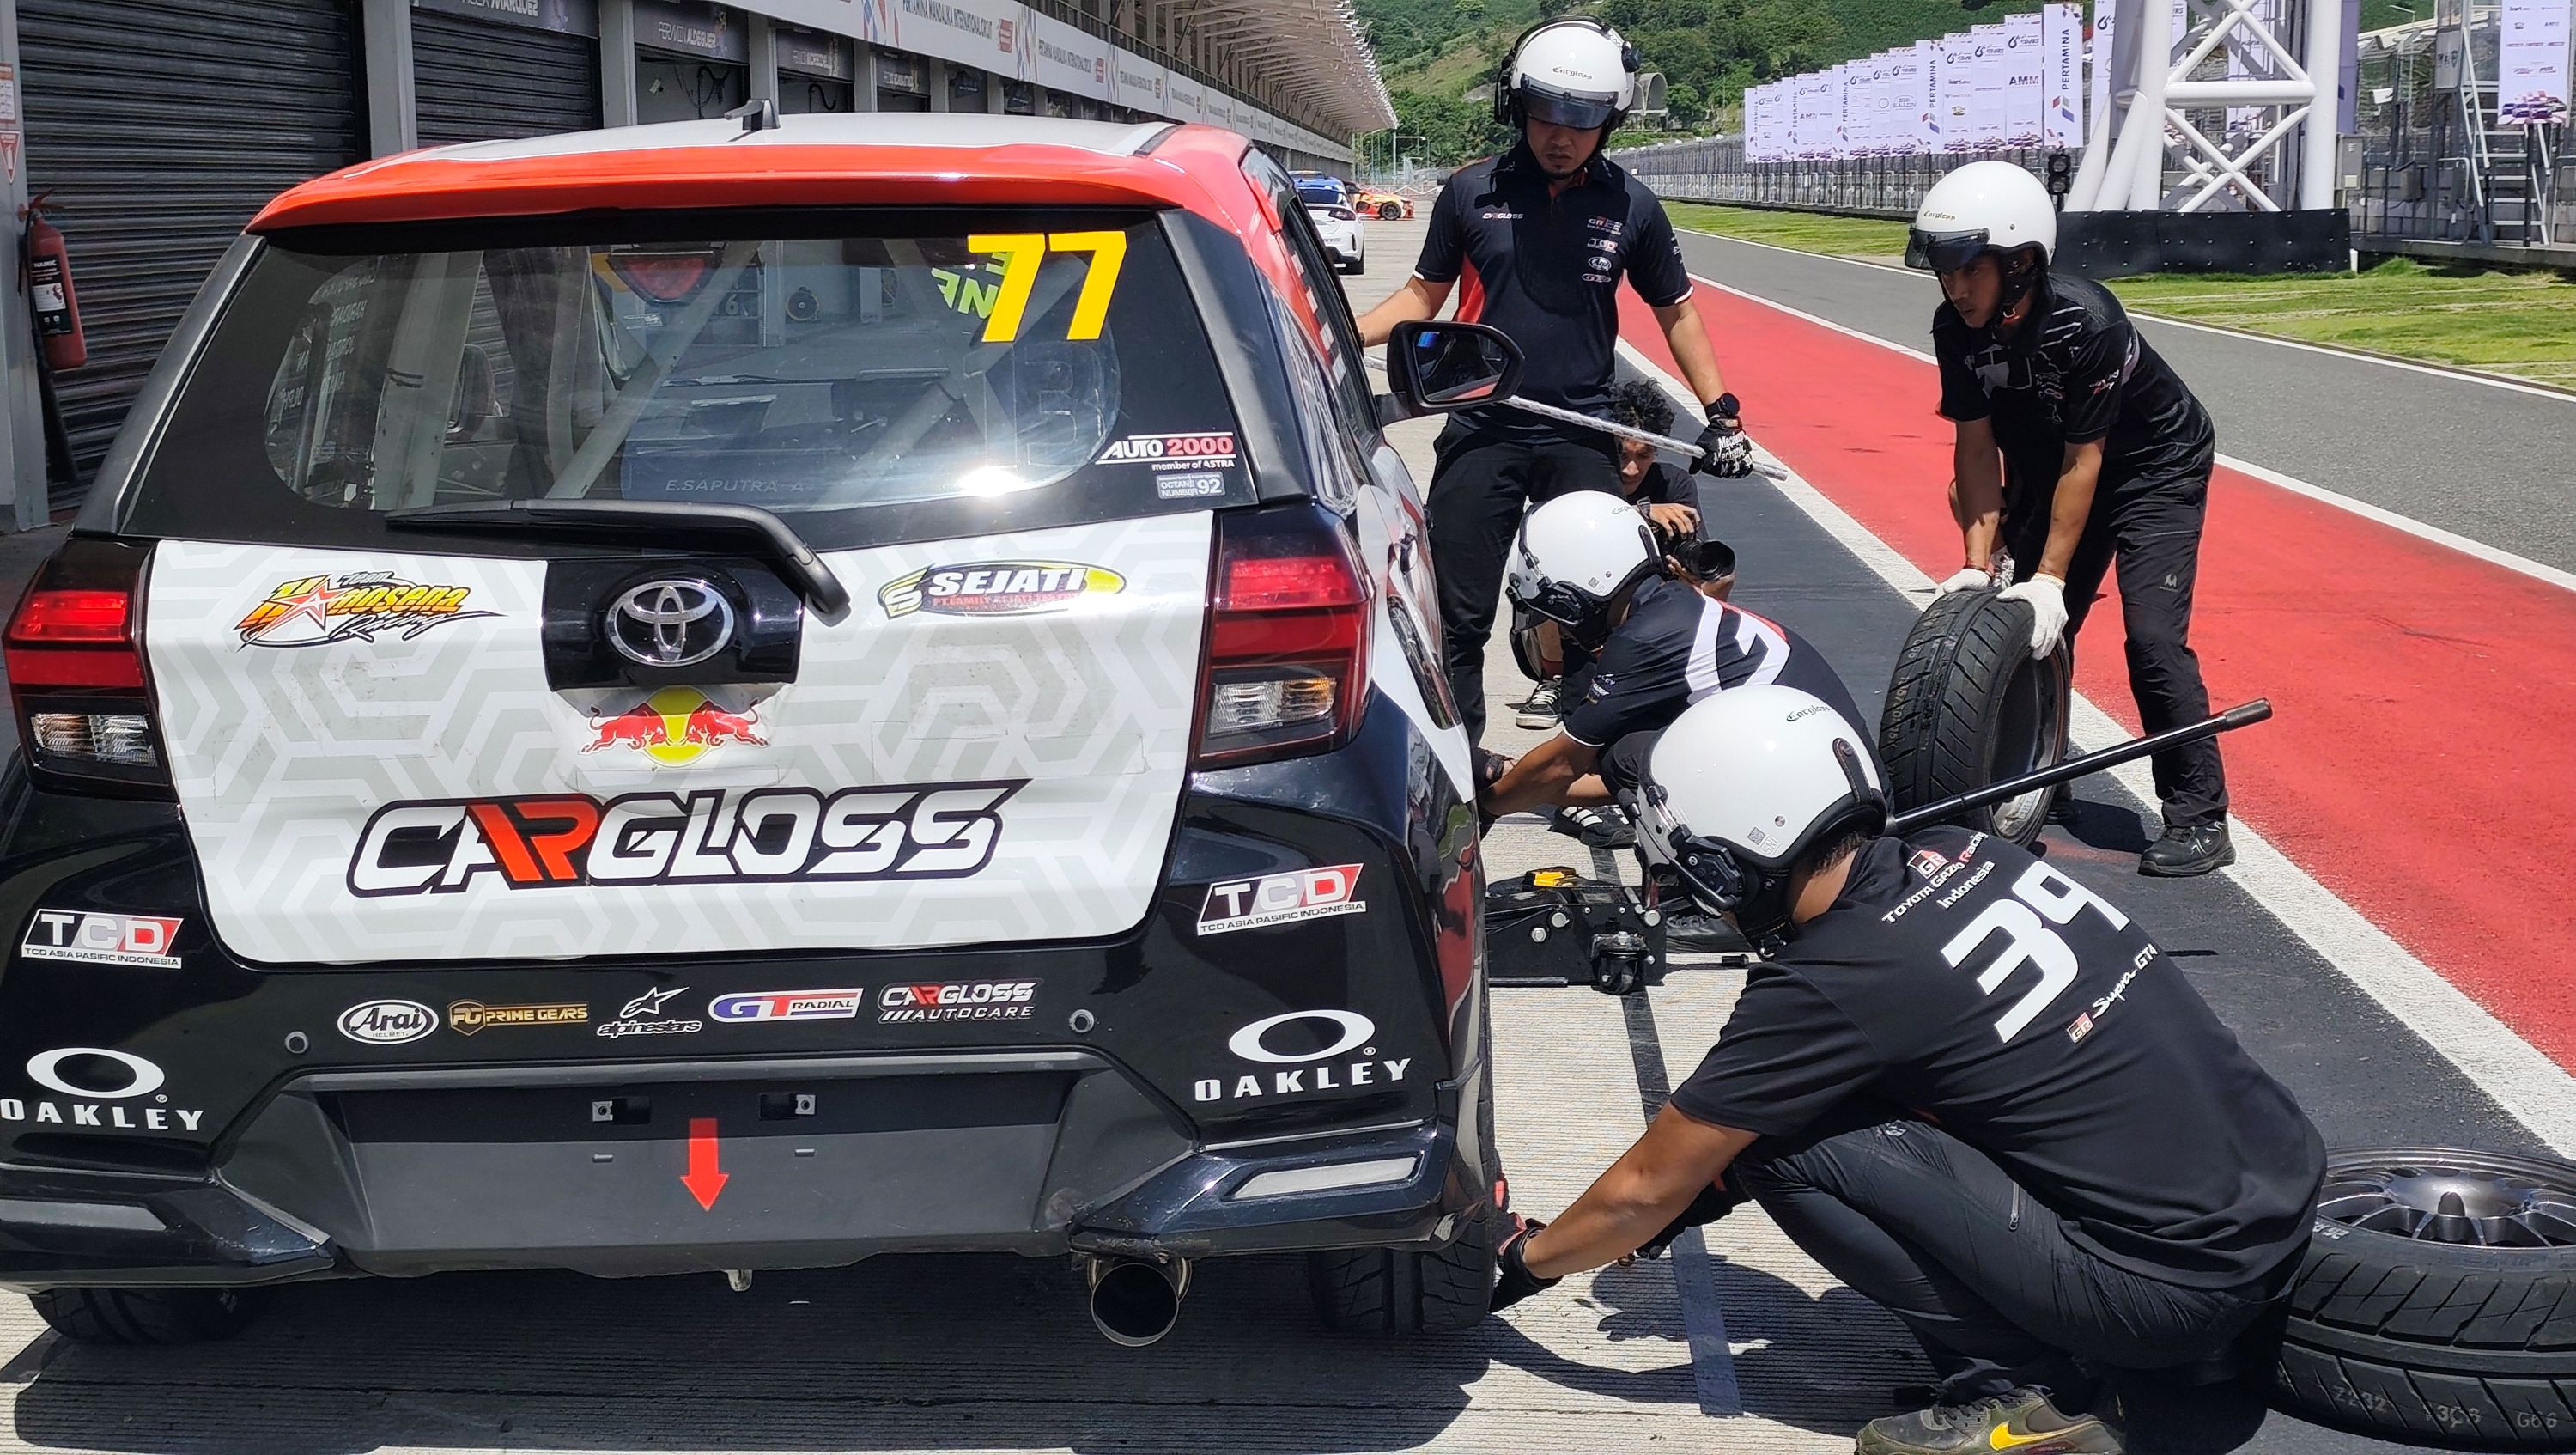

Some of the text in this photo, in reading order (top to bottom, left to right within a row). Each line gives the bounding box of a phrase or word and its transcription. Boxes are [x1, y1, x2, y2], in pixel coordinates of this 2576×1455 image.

[2062, 28, 2070, 90] PERTAMINA
[967, 230, 1127, 342] 77
[1100, 437, 1234, 460] AUTO 2000
[1151, 460, 1235, 472] member of ASTRA
[1160, 478, 1223, 495] OCTANE 92
[1161, 488, 1199, 497] NUMBER
[927, 567, 1088, 597] SEJATI
[1786, 704, 1831, 722] Cargloss
[348, 778, 1026, 896] CARGLOSS
[1214, 870, 1346, 916] TCD
[1935, 861, 1996, 910] Indonesia
[1200, 902, 1364, 934] TCD ASIA PASIFIC INDONESIA
[1881, 885, 1935, 923] TOYOTA
[40, 913, 165, 953] TCD
[24, 947, 179, 967] TCD ASIA PASIFIC INDONESIA
[1940, 859, 2131, 1045] 39
[881, 982, 1036, 1008] CARGLOSS
[2092, 969, 2138, 1020] Supra
[2134, 943, 2159, 971] GT4
[350, 1007, 422, 1032] Arai
[486, 1005, 589, 1022] PRIME GEARS
[713, 995, 854, 1019] GT RADIAL
[596, 1019, 703, 1039] alpinestars
[1194, 1057, 1413, 1102] OAKLEY
[0, 1098, 204, 1132] OAKLEY
